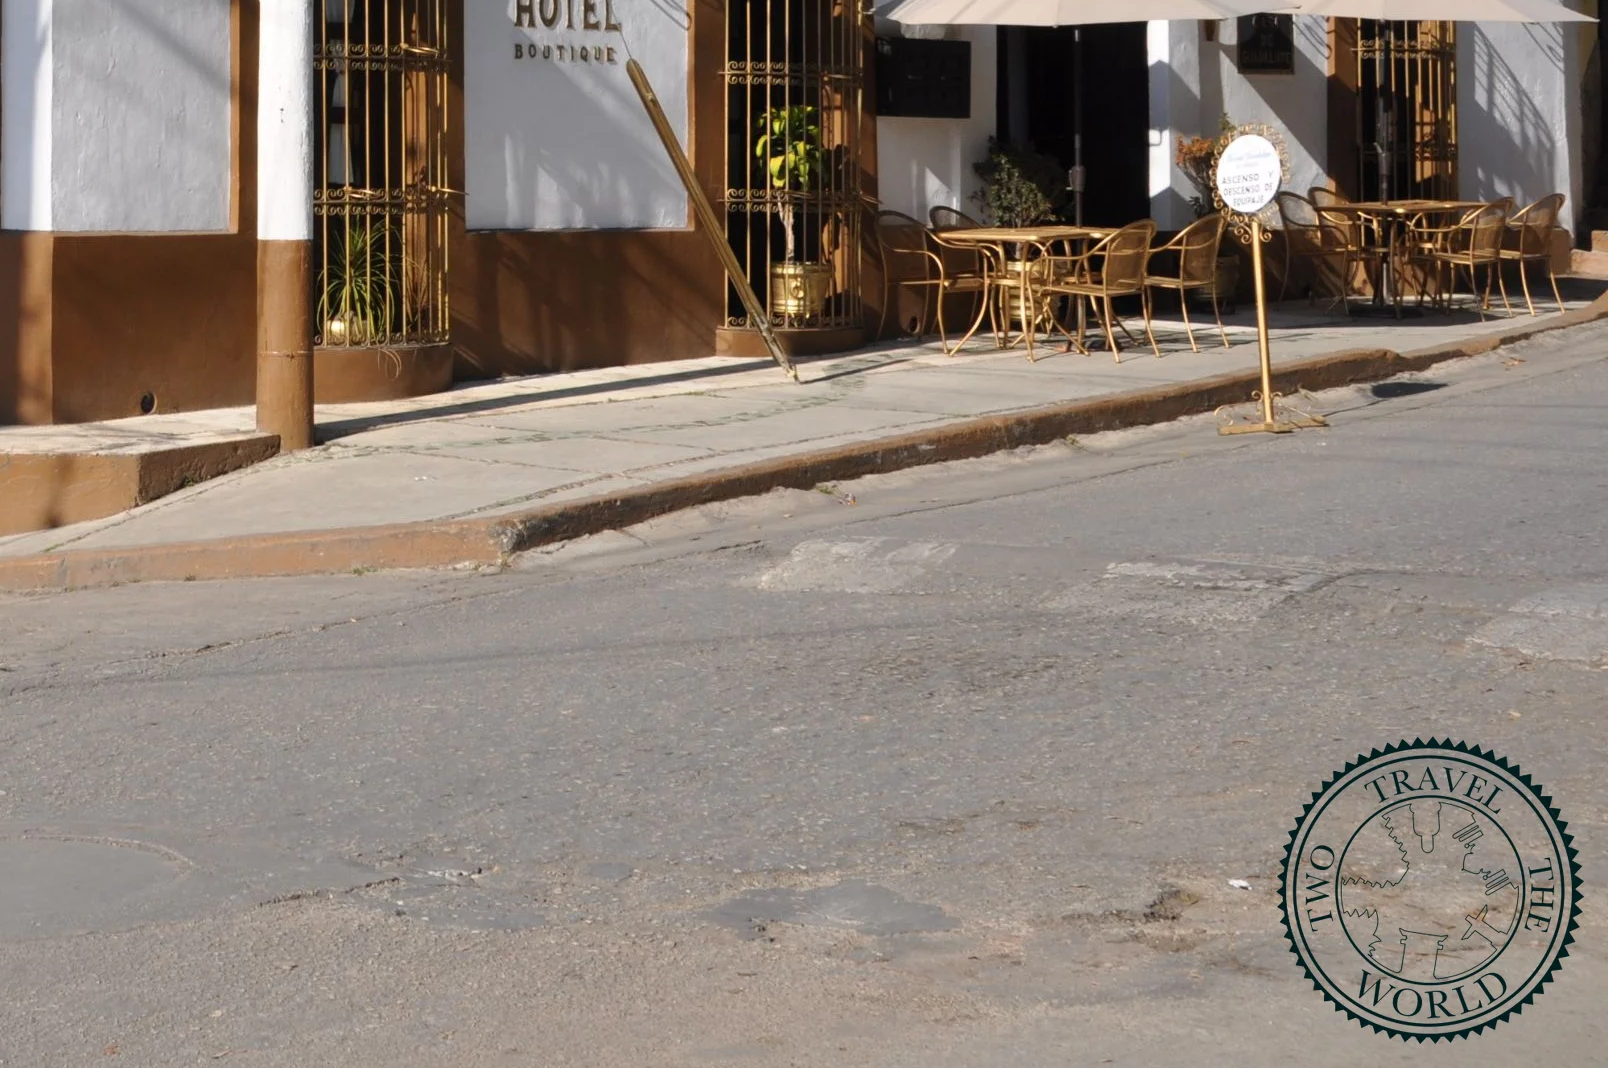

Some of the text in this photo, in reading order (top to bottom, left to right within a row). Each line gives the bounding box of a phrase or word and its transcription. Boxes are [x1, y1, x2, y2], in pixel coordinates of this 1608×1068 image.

[514, 43, 616, 62] BOUTIQUE
[1221, 173, 1259, 184] ASCENSO
[1223, 184, 1260, 196] DESCENSO
[1233, 195, 1264, 207] EQUIPAJE
